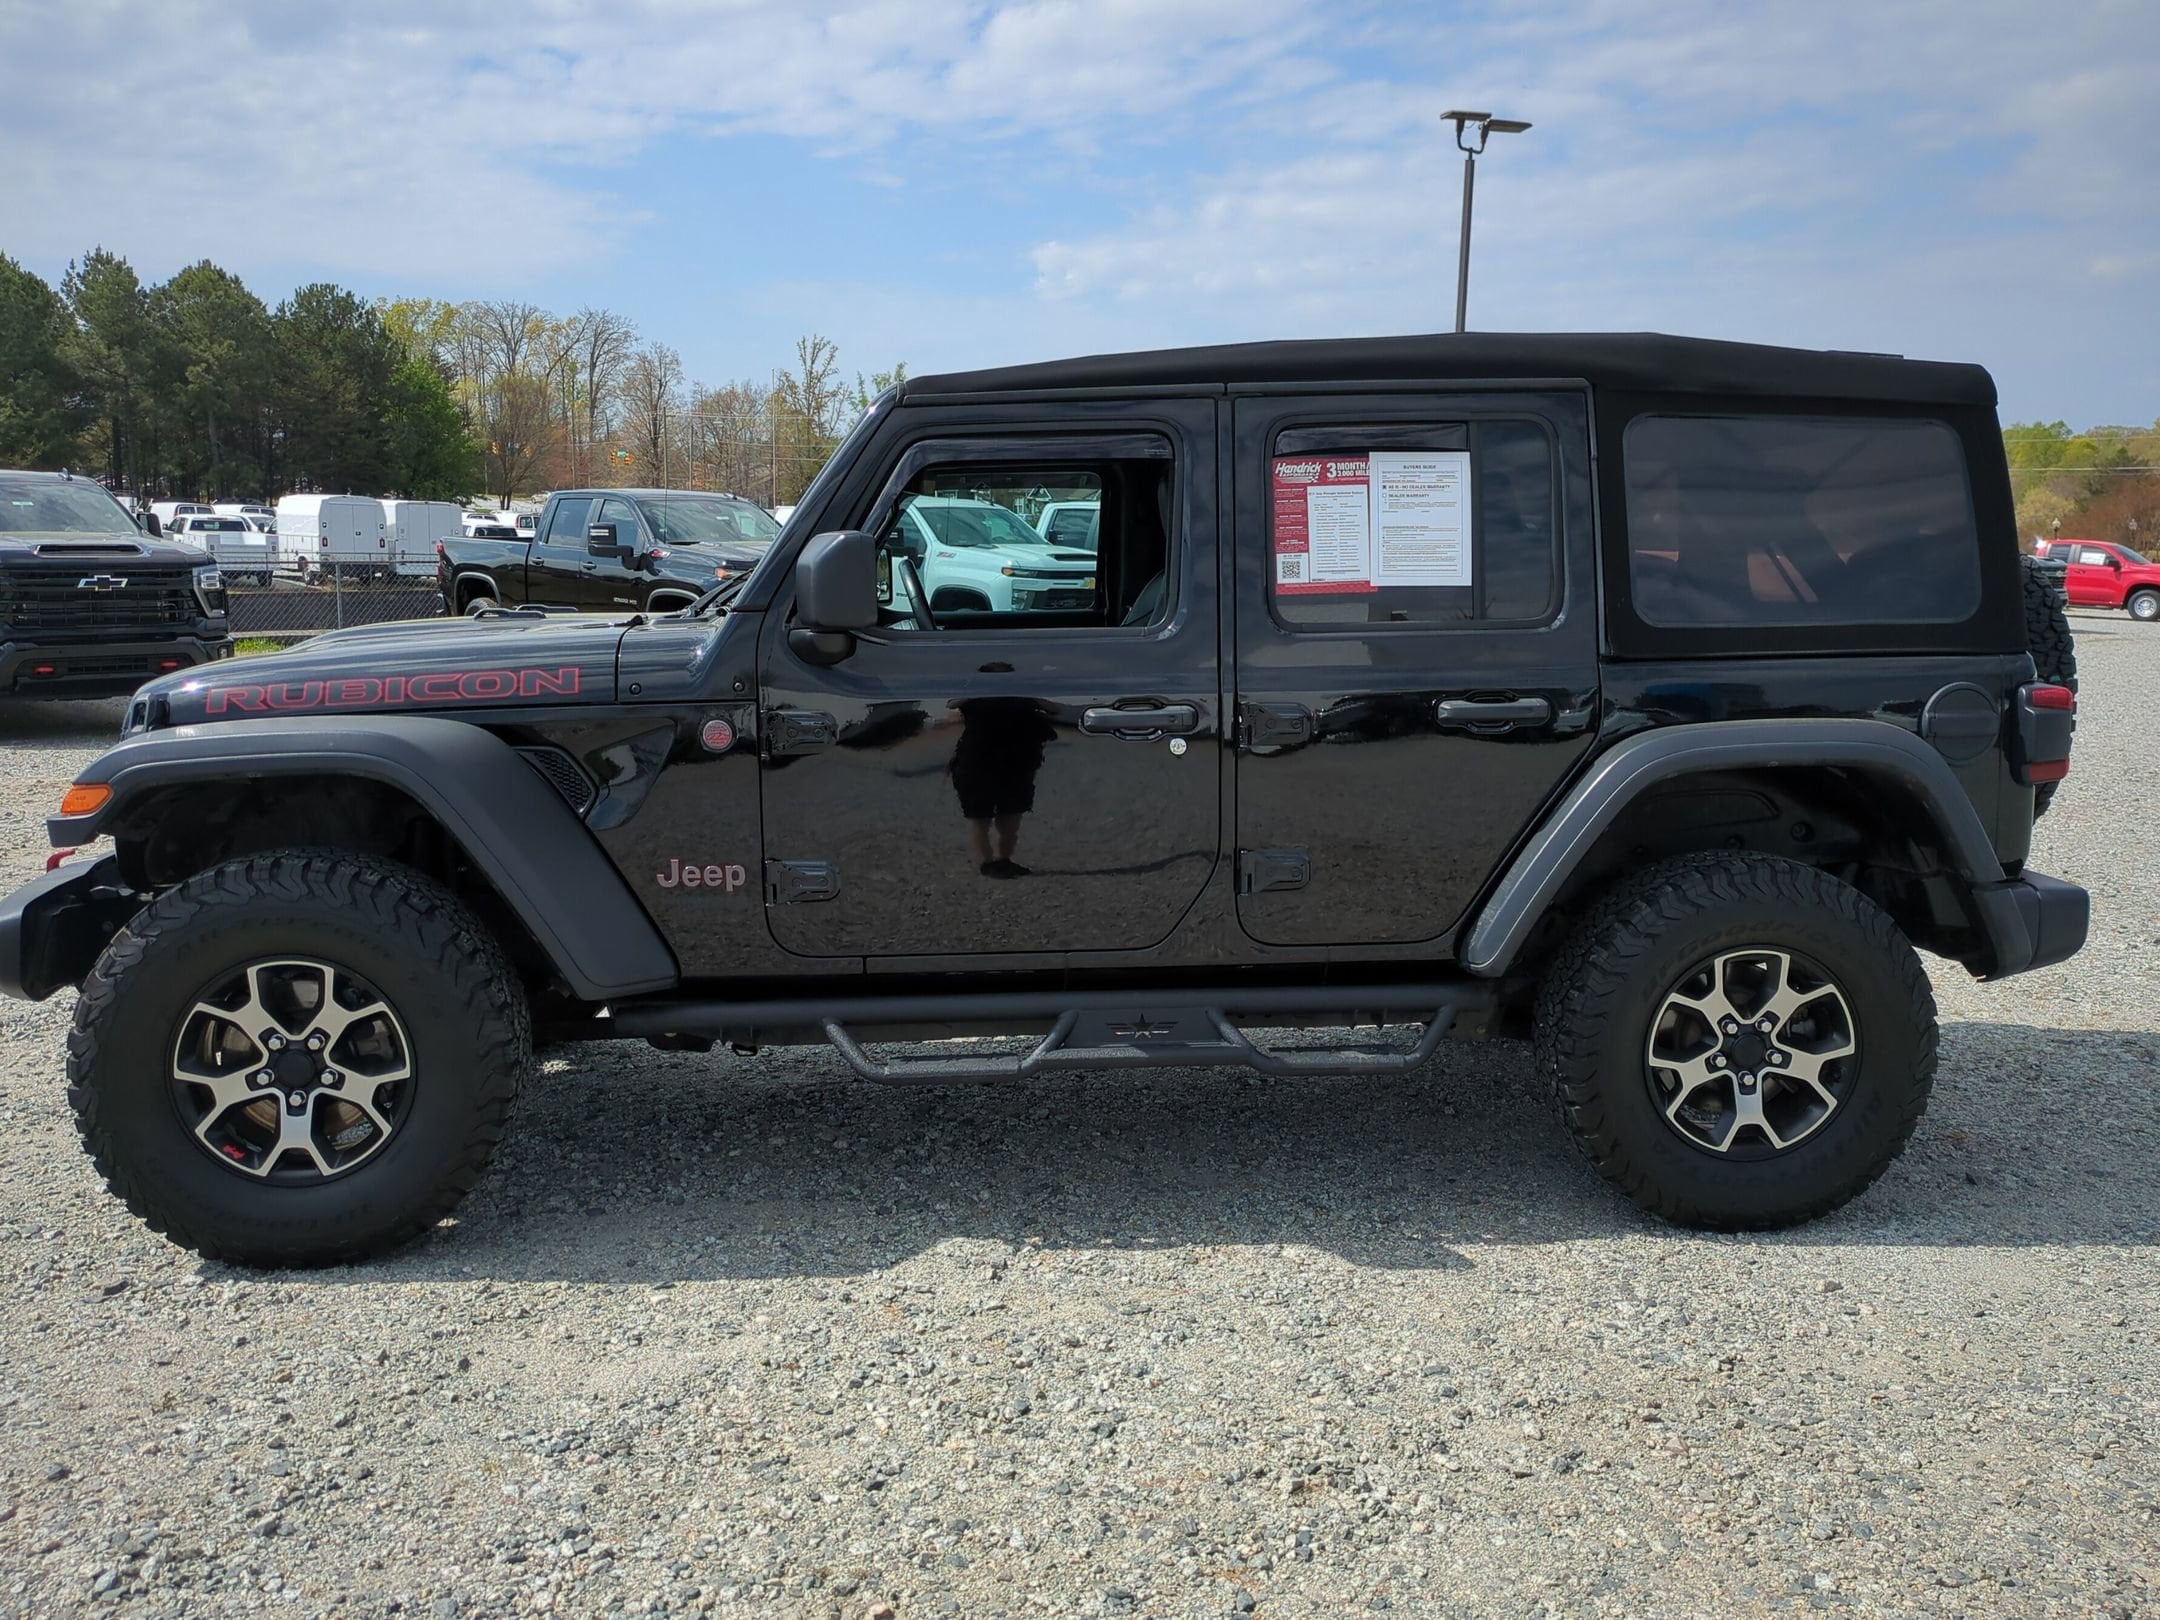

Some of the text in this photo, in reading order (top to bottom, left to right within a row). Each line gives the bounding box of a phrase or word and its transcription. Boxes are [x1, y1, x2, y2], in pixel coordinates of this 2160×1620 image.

[1326, 462, 1337, 478] 3
[206, 667, 580, 713] RUBICON
[656, 859, 746, 892] Jeep
